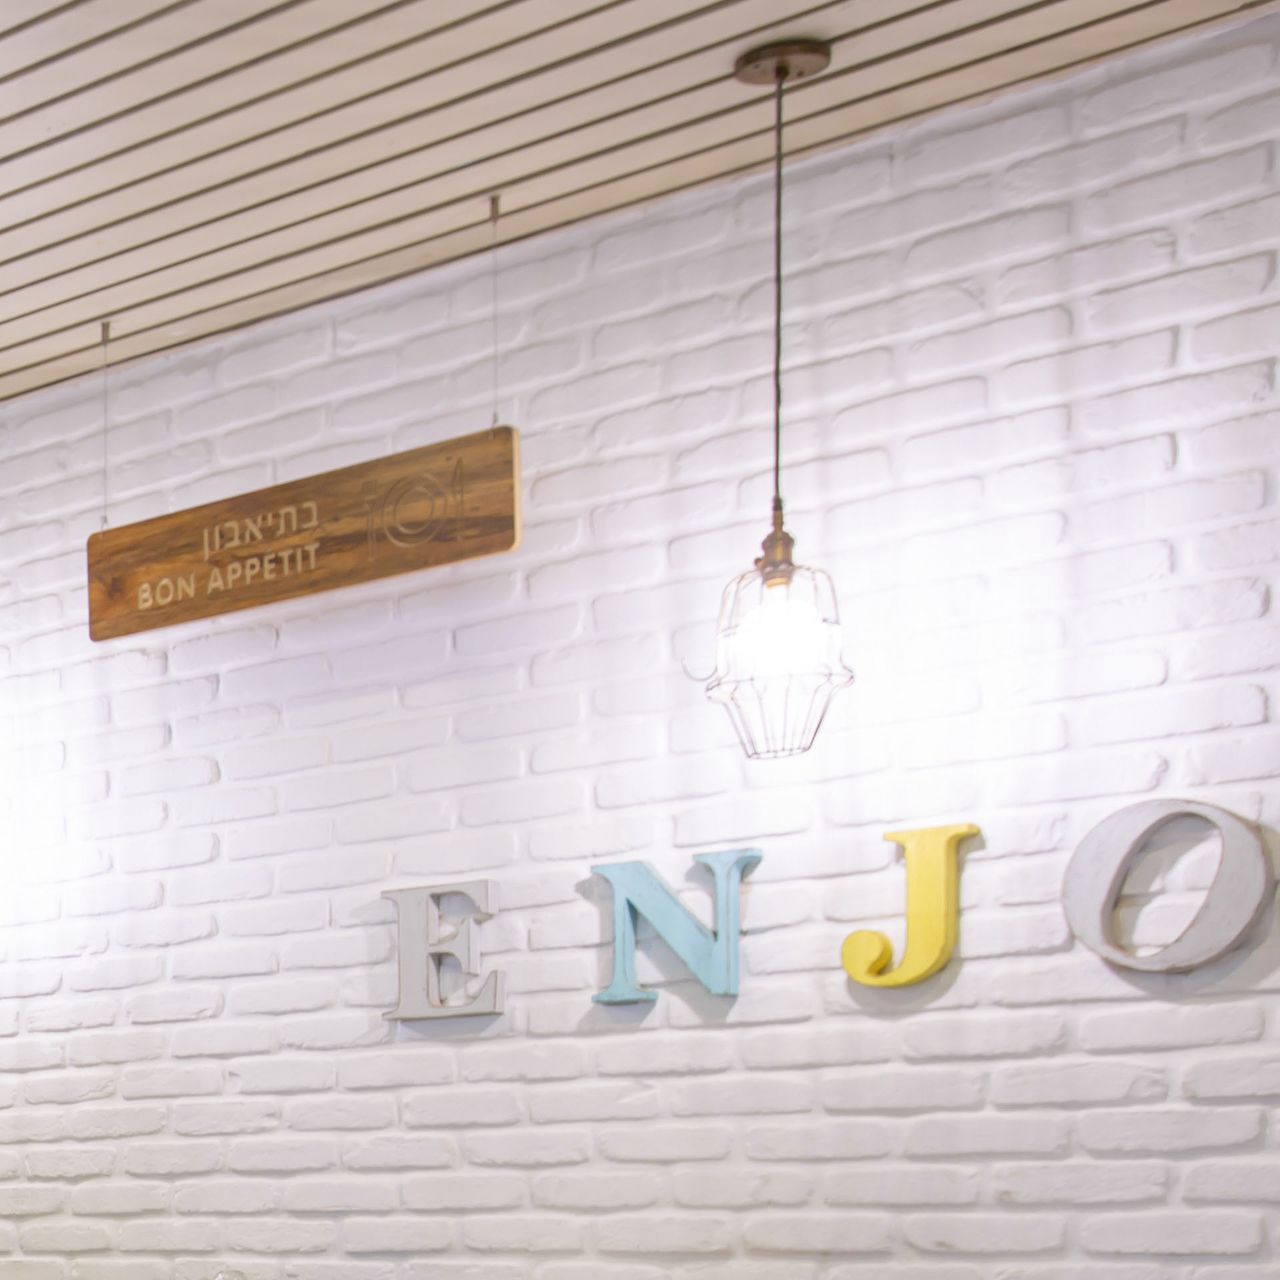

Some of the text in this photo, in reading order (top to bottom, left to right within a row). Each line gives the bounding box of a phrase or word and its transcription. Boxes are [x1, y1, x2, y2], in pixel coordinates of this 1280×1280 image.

[203, 501, 319, 560] בתיאבון
[137, 542, 320, 610] BON APPETIT
